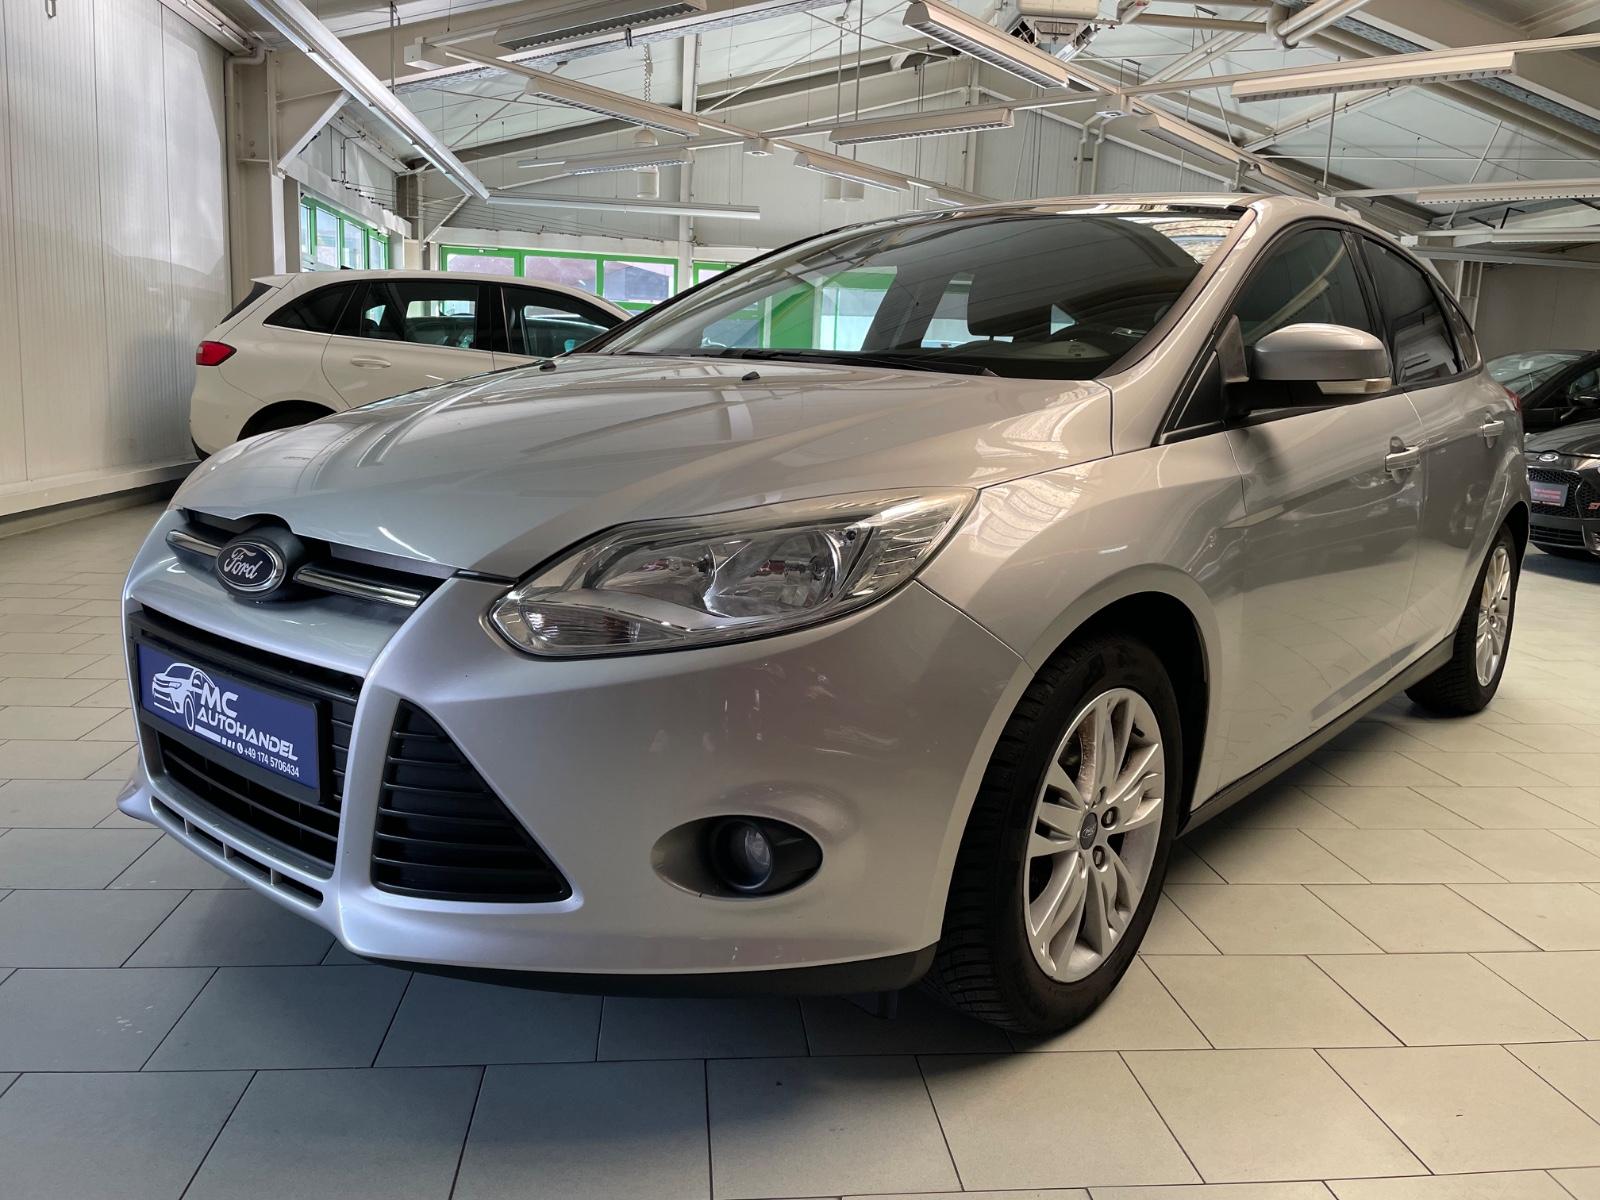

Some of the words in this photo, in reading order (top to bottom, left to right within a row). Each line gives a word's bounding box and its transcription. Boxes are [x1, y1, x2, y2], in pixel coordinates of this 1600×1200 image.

[223, 547, 263, 579] Ford
[200, 682, 239, 719] MC
[197, 706, 299, 761] AUTOHANDEL
[244, 747, 257, 760] +49
[257, 751, 269, 765] 174
[270, 756, 300, 778] 5706434
